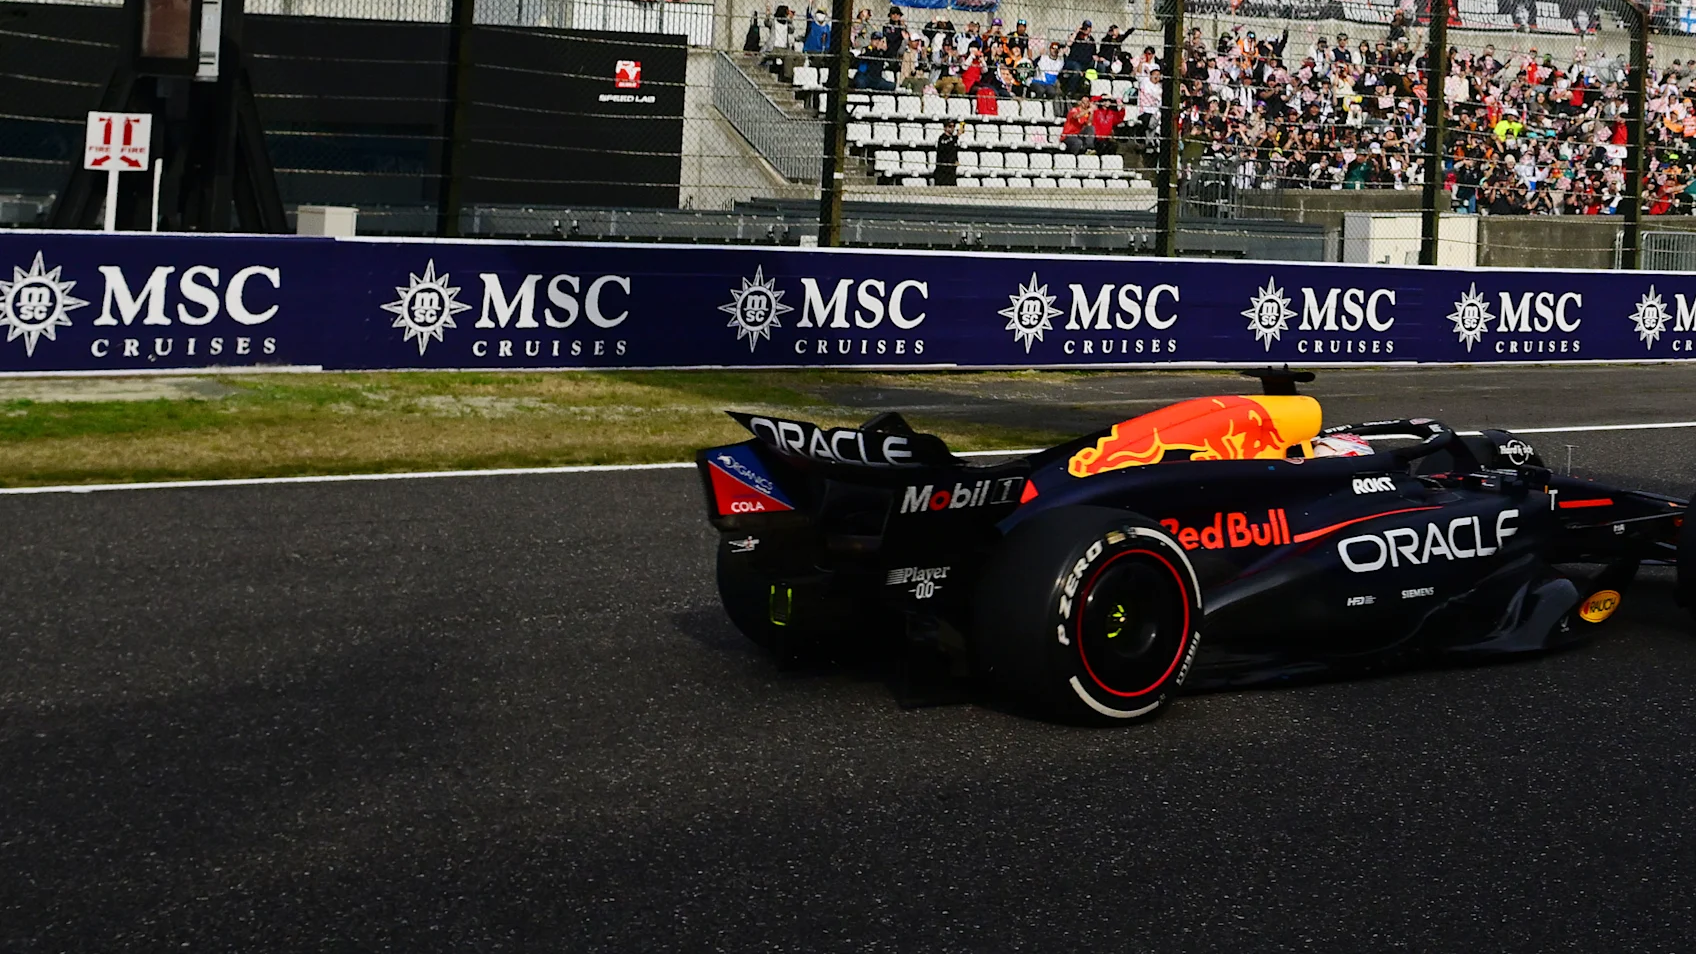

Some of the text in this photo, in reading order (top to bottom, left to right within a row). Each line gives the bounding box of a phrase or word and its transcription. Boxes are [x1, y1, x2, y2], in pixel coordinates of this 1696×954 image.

[94, 266, 280, 325] MSC
[475, 273, 630, 328] MSC
[797, 278, 928, 329] MSC
[1063, 284, 1179, 329] MSC
[1296, 288, 1395, 331] MSC
[1495, 292, 1581, 332] MSC
[91, 337, 277, 359] CRUISES
[473, 340, 626, 356] CRUISES
[795, 340, 923, 354] CRUISES
[1064, 340, 1176, 354] CRUISES
[1298, 340, 1393, 353] CRUISES
[1496, 341, 1579, 353] CRUISES
[749, 417, 913, 464] ORACLE
[900, 481, 988, 514] Mobil
[1352, 476, 1397, 494] ROKT
[730, 501, 765, 513] COLA
[1160, 508, 1290, 551] Red Bull
[1338, 509, 1521, 573] ORACLE
[903, 566, 950, 584] Player
[1058, 539, 1104, 620] ZERO
